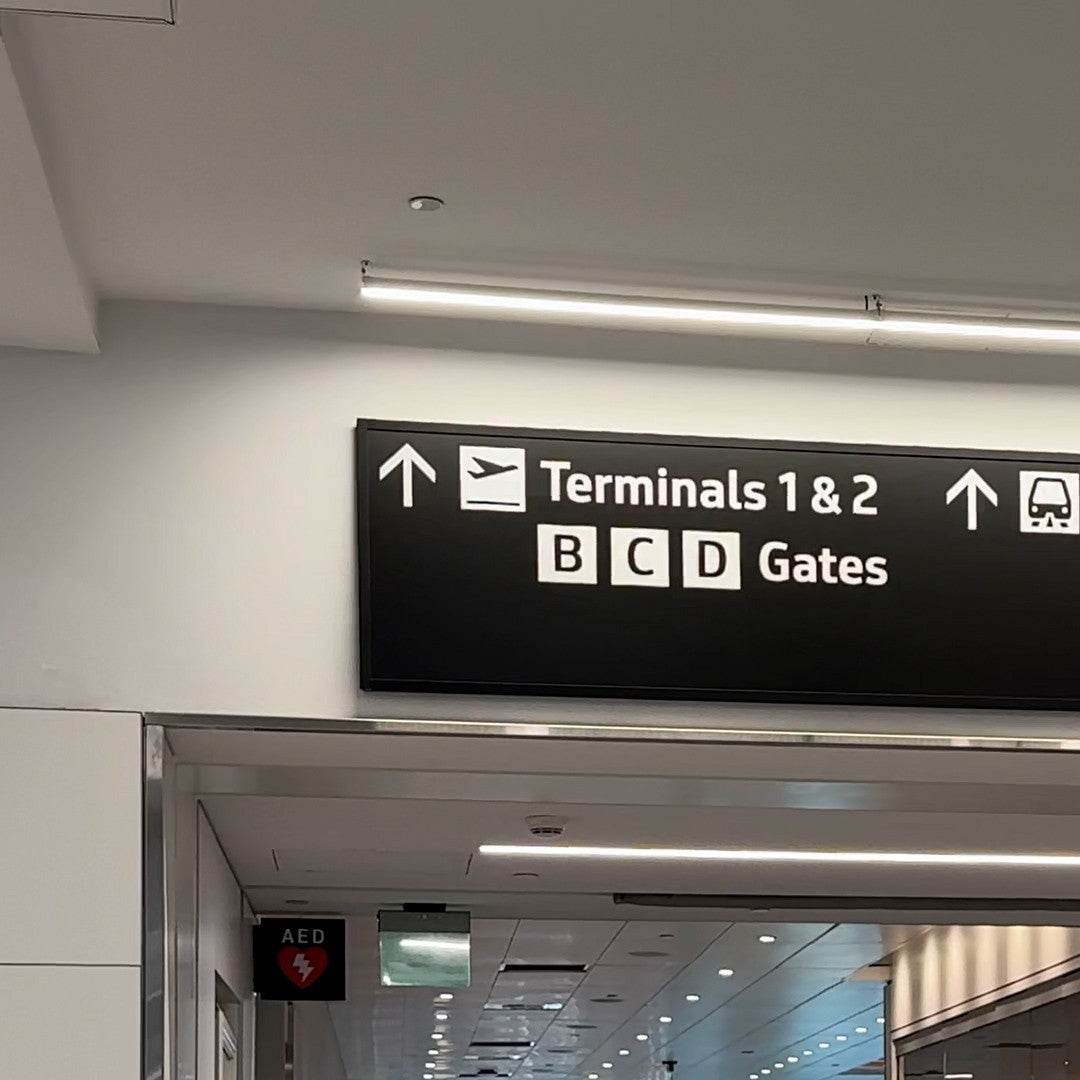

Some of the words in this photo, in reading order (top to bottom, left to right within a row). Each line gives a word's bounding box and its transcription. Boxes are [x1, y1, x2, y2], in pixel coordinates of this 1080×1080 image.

[539, 460, 767, 512] Terminals
[777, 472, 797, 512] 1
[810, 476, 842, 515] &
[852, 474, 878, 515] 2
[553, 534, 583, 573] B
[626, 537, 655, 576] C
[697, 540, 727, 579] D
[758, 542, 889, 587] Gates
[281, 928, 325, 944] AED
